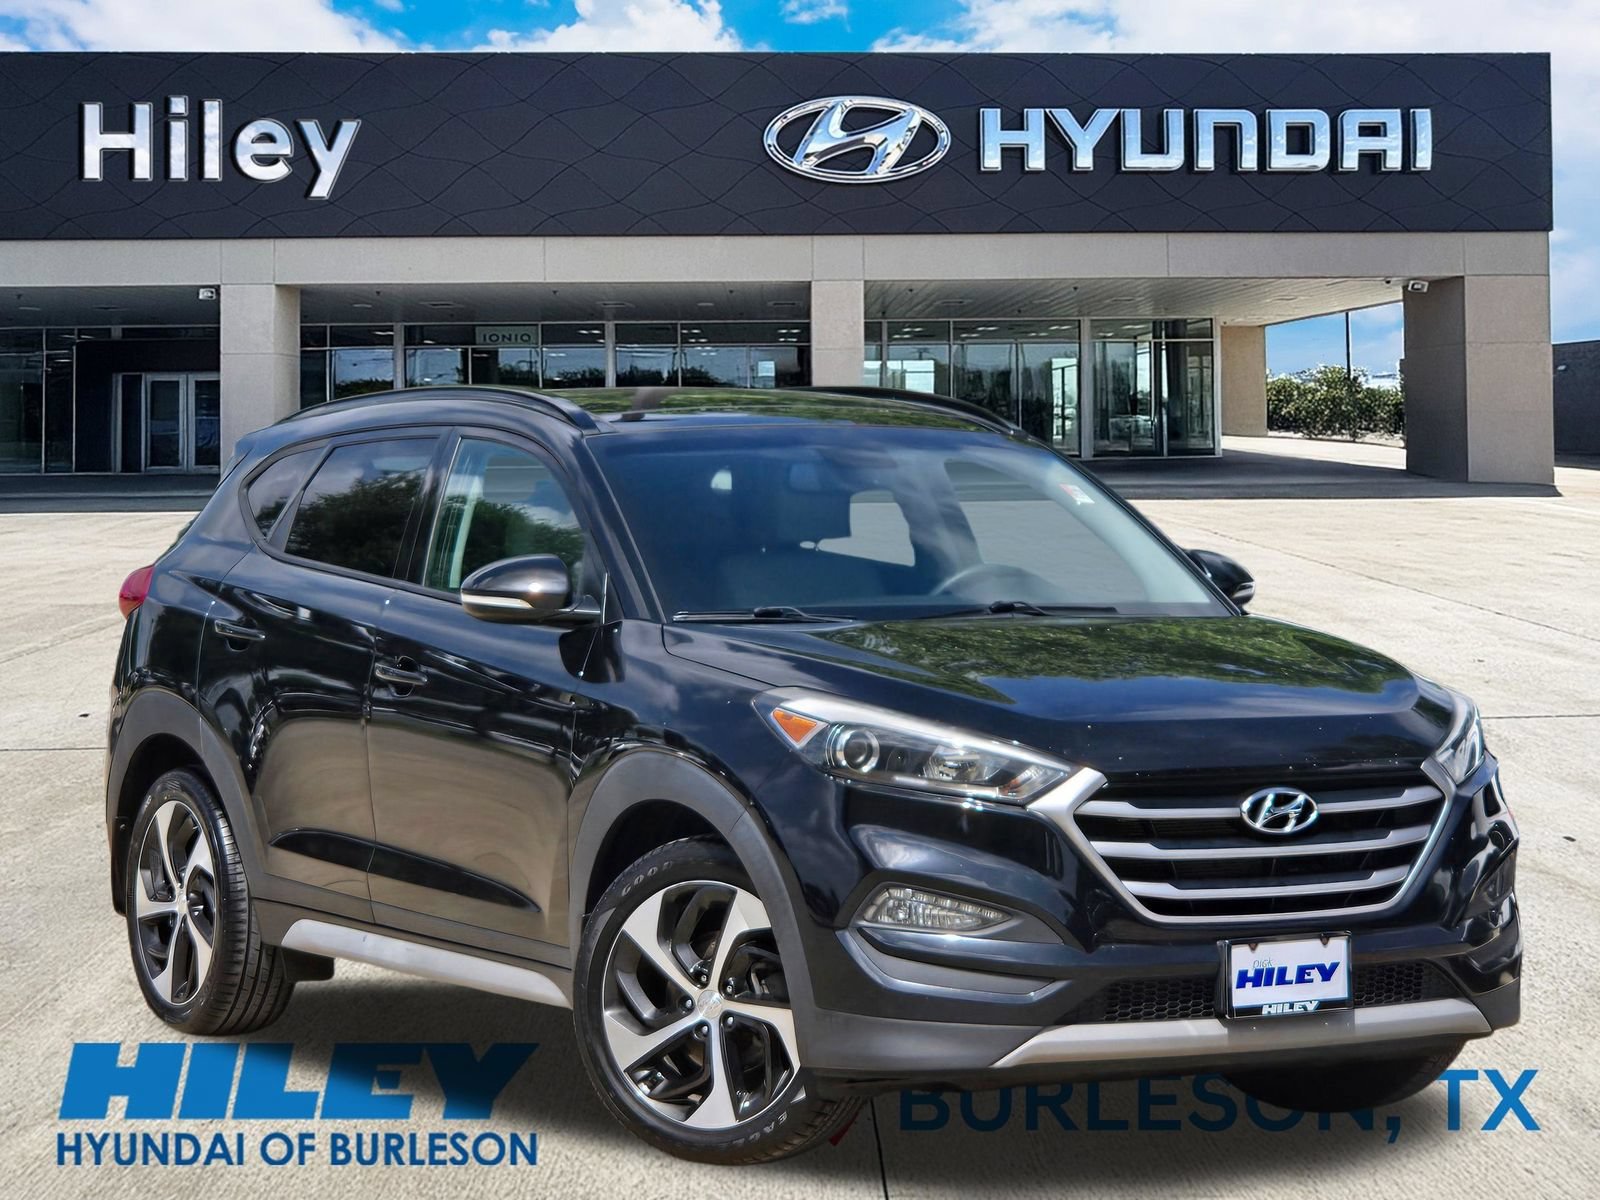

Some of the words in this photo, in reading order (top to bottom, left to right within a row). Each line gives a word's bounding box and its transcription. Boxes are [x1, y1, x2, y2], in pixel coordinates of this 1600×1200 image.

[79, 95, 361, 199] Hiley
[980, 108, 1432, 171] HYUNDAI
[1236, 961, 1340, 989] HILEY
[1262, 1000, 1319, 1015] HILEY
